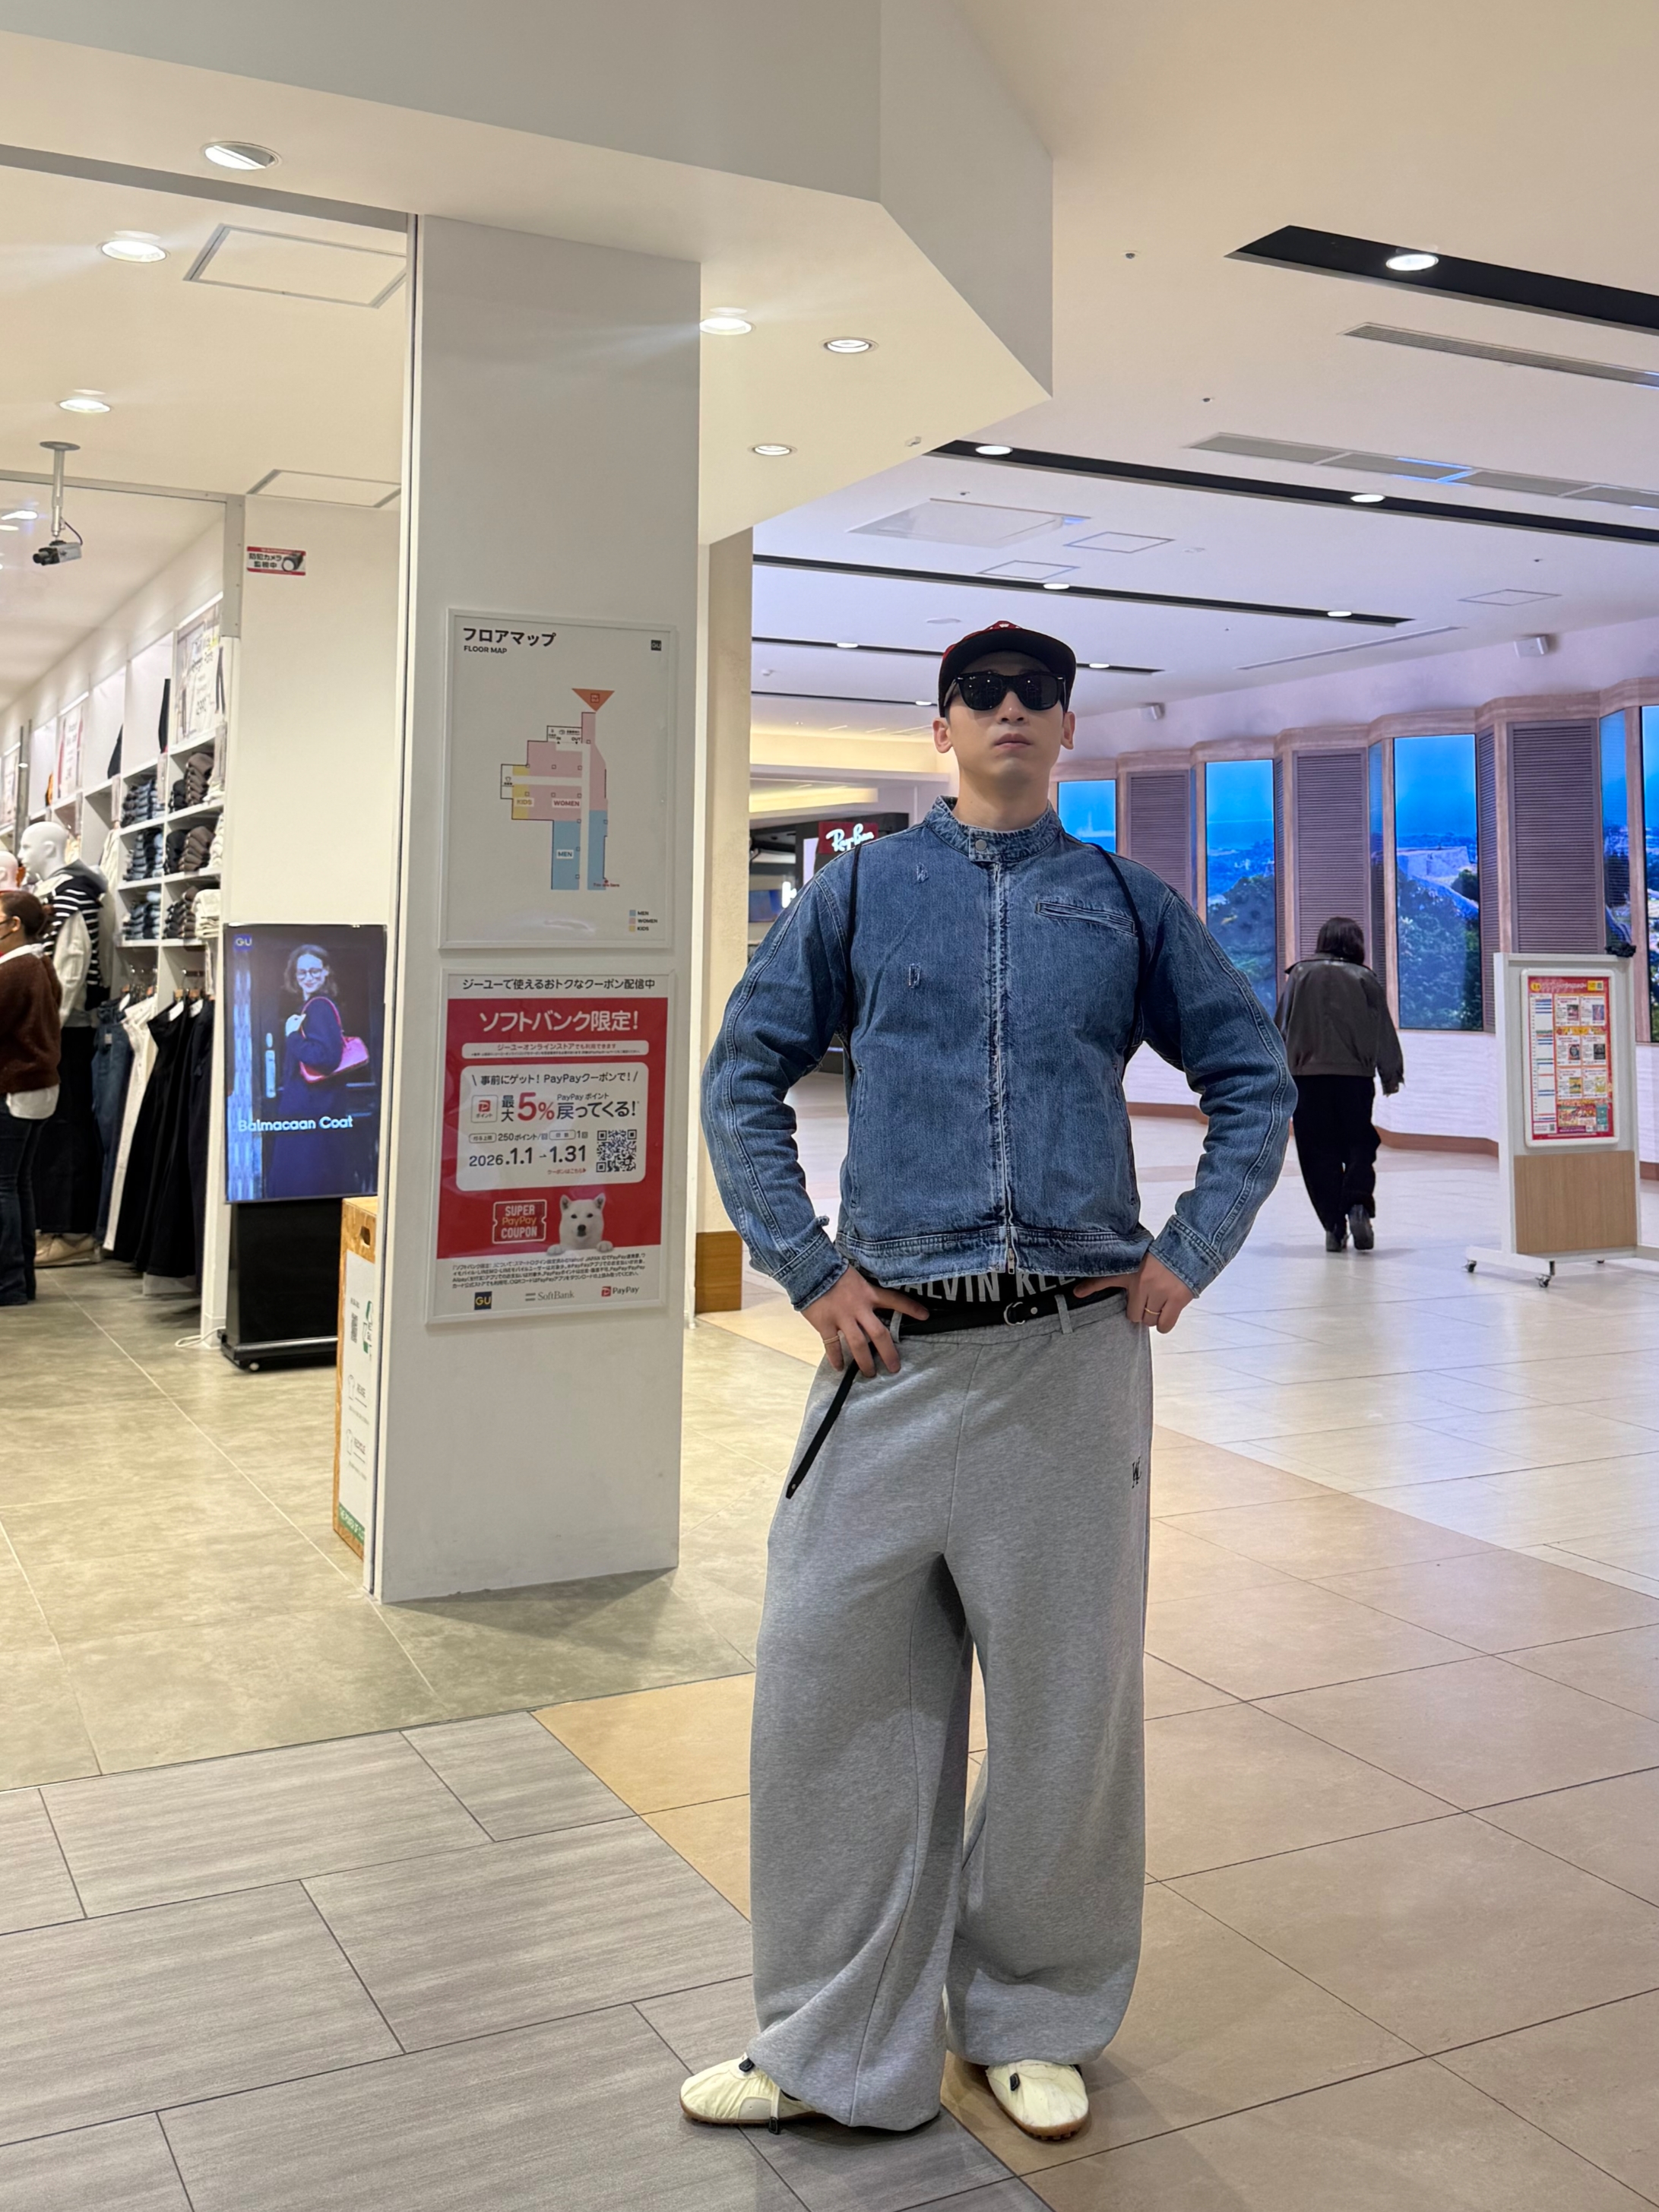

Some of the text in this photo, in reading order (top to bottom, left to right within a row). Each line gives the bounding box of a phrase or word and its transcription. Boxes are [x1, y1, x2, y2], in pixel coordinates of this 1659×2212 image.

[463, 628, 556, 647] フロアマップ
[236, 937, 252, 947] GU
[462, 979, 655, 990] ジーユーで使えるおトクなクーポン配信中
[517, 1092, 555, 1121] 5%
[238, 1115, 353, 1132] Balmacaan Coat
[505, 1204, 536, 1217] SUPER
[502, 1216, 537, 1226] PayPay
[501, 1226, 537, 1239] COUPON
[612, 1286, 640, 1295] PayPay
[893, 1274, 1001, 1302] ALVIN
[474, 1296, 492, 1306] GU
[537, 1290, 575, 1301] SoftBank
